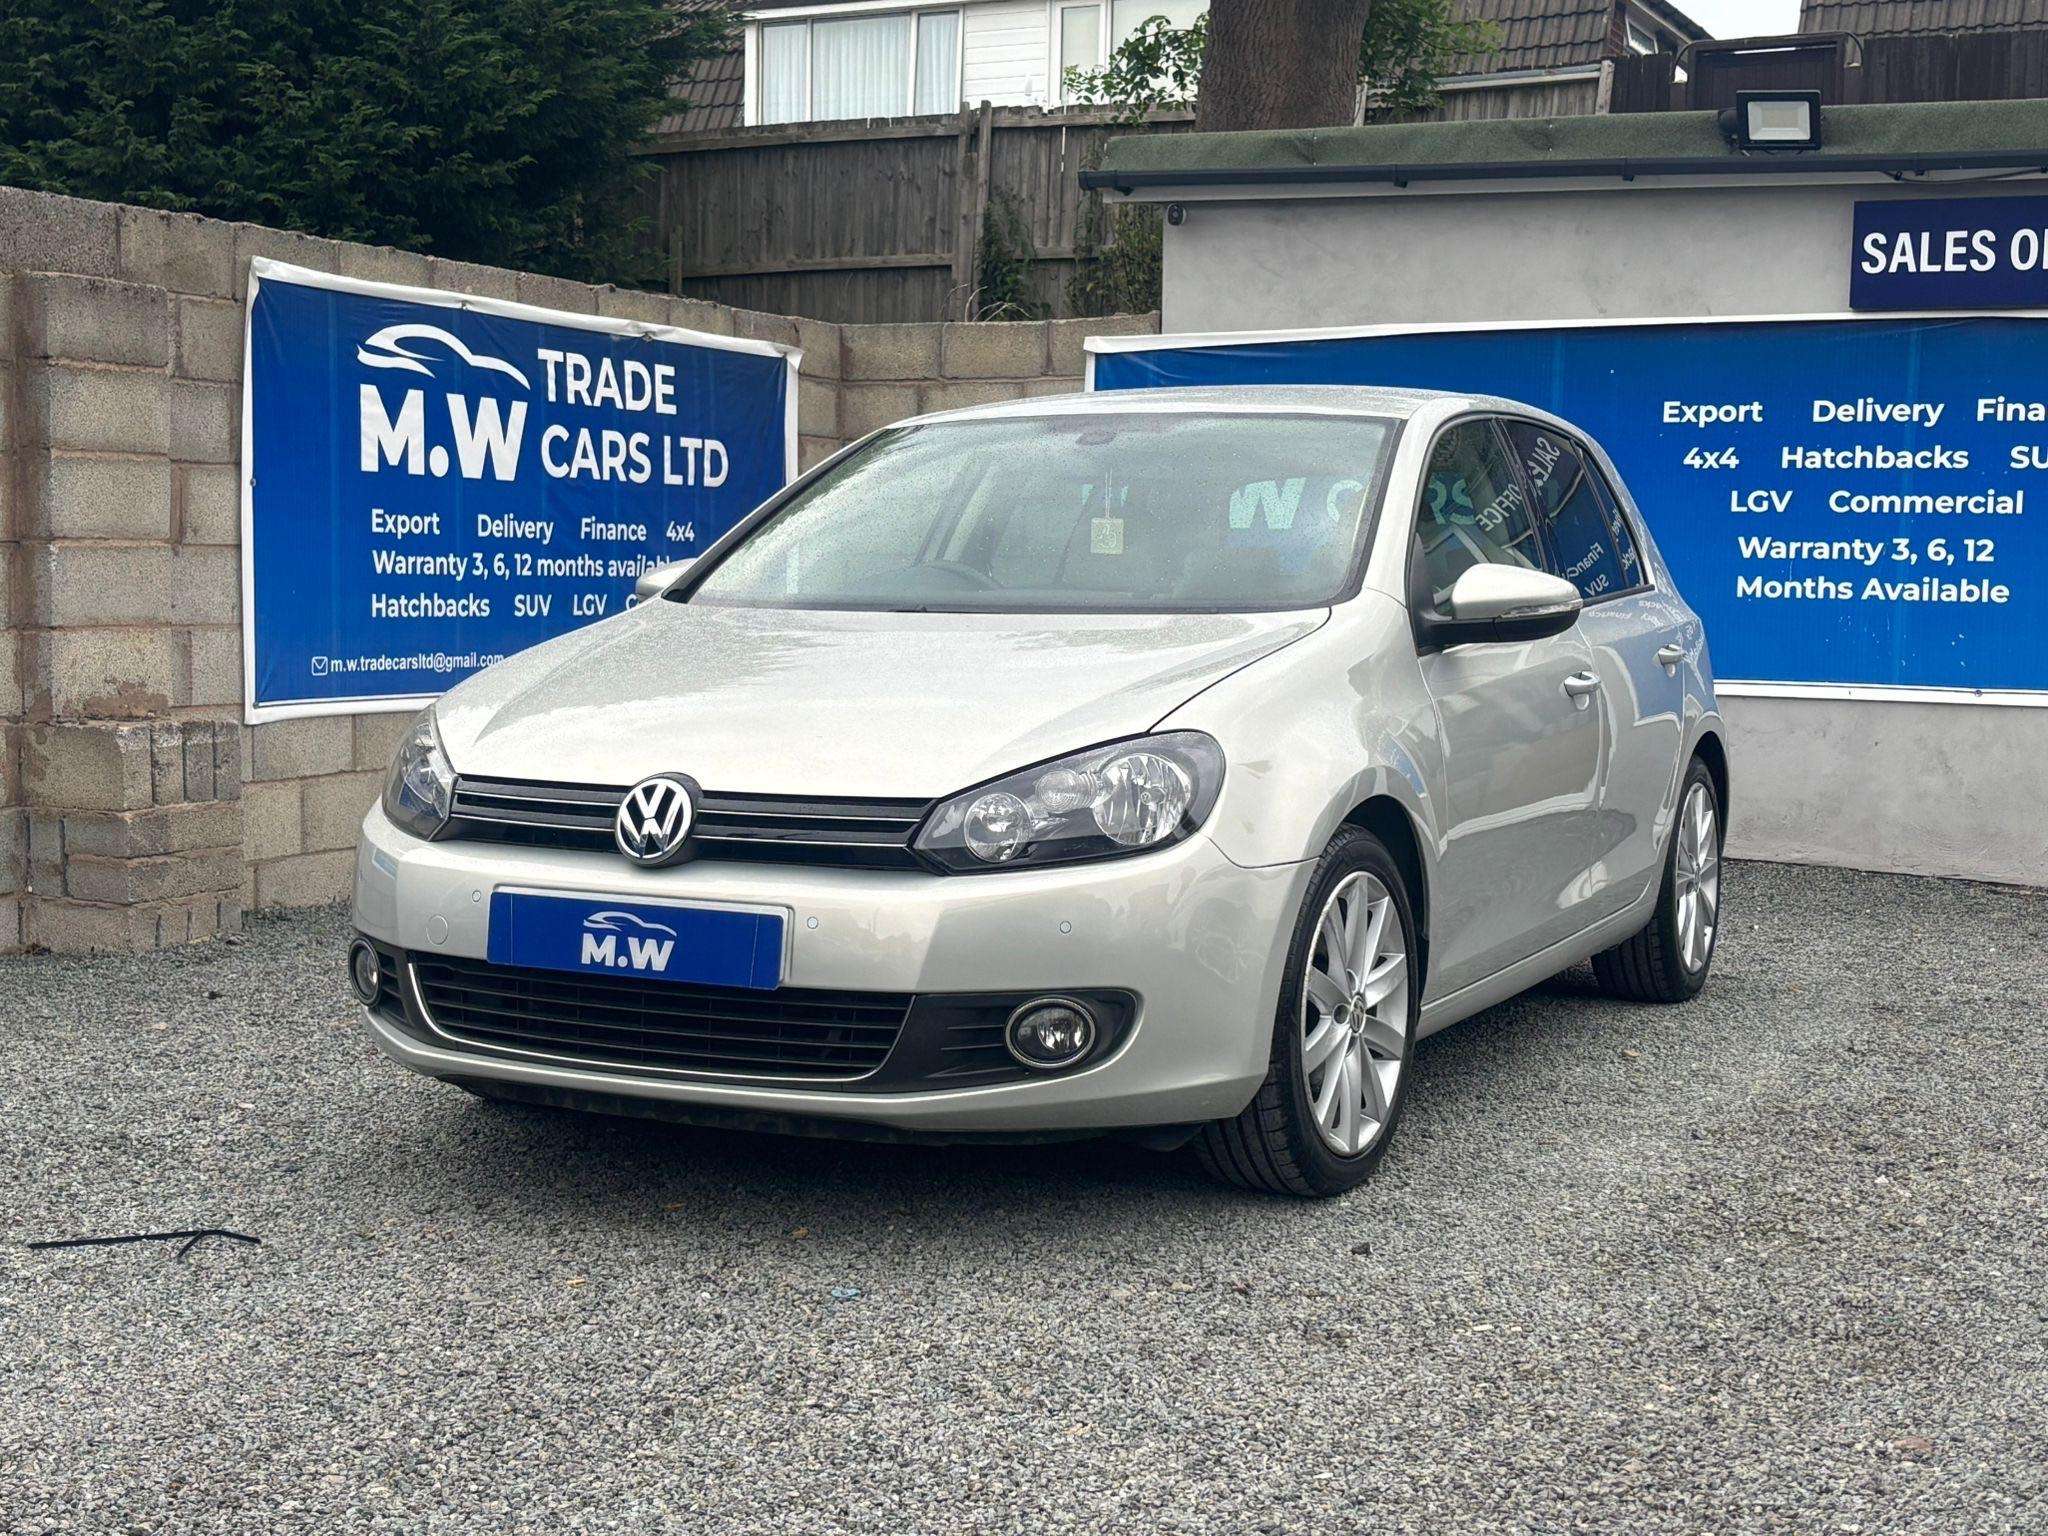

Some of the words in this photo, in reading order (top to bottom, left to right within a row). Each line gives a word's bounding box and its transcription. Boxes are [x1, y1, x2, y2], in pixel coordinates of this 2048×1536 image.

[1862, 230, 1995, 273] SALES
[2011, 229, 2048, 270] O
[538, 349, 676, 414] TRADE
[1663, 401, 1762, 427] Export
[1813, 398, 1944, 427] Delivery
[359, 383, 529, 482] M.W
[542, 425, 651, 483] CARS
[664, 436, 728, 487] LTD
[1684, 448, 1739, 468] 4x4
[1782, 445, 1968, 468] Hatchbacks
[1731, 491, 1792, 512] LGV
[1829, 489, 2023, 513] Commercial
[372, 509, 439, 539] Export
[478, 514, 553, 544] Delivery
[581, 516, 646, 540] Finance
[667, 522, 694, 541] 4x4
[373, 551, 467, 580] Warranty
[473, 553, 488, 579] 3,
[494, 553, 509, 580] 6,
[515, 554, 531, 575] 12
[538, 554, 603, 576] months
[607, 554, 670, 578] avail
[1739, 537, 1883, 565] Warranty
[1892, 539, 1917, 564] 3,
[1928, 539, 1954, 565] 6,
[1964, 539, 1993, 561] 12
[1737, 576, 1852, 599] Months
[1862, 577, 2009, 602] Available
[372, 593, 490, 617] Hatchbacks
[515, 595, 551, 616] SUV
[573, 593, 607, 616] LGV
[581, 932, 675, 972] M.W
